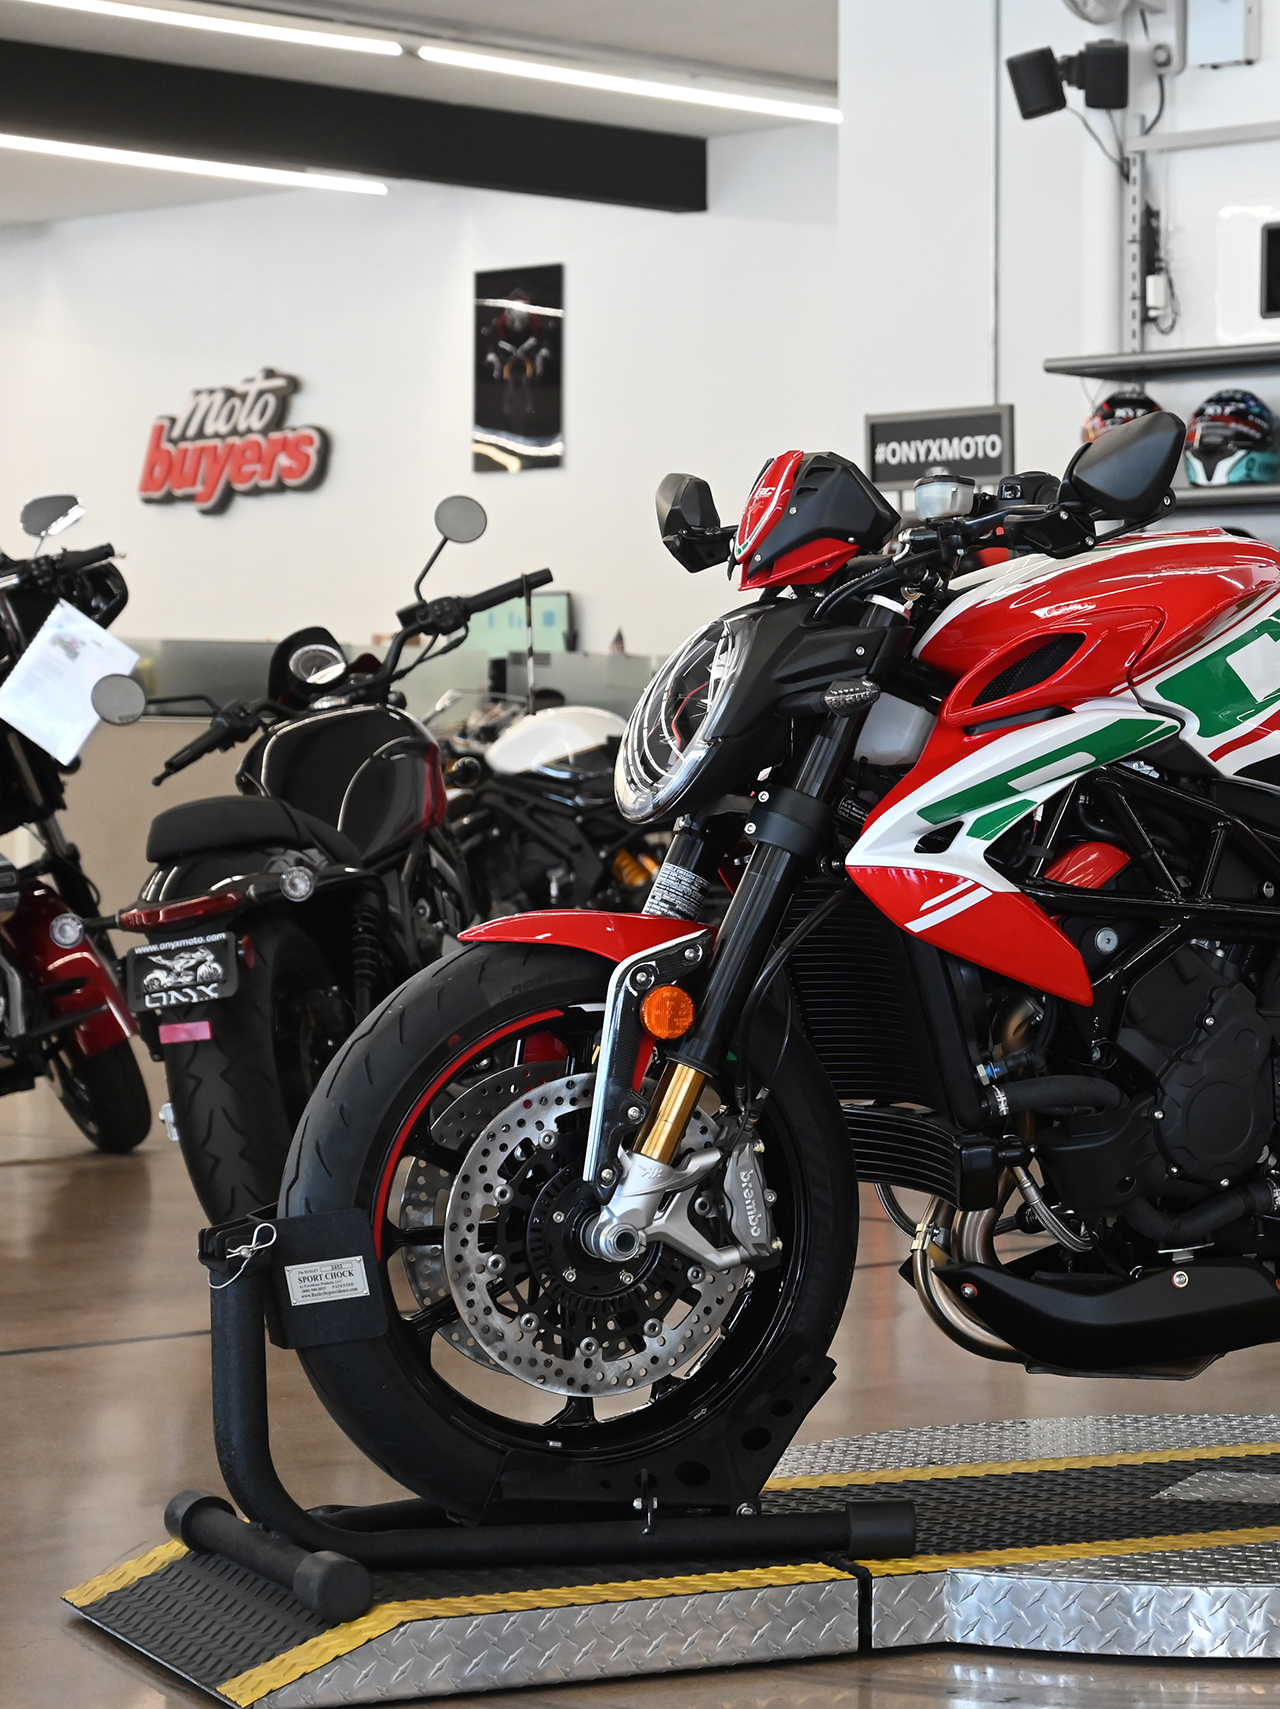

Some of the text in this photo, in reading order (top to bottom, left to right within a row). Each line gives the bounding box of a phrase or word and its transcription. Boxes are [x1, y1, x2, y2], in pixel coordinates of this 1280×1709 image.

[170, 371, 288, 439] Moto
[138, 422, 317, 506] buyers
[874, 433, 1003, 466] #ONYXMOTO
[134, 932, 226, 955] www.onyxmoto.com
[145, 983, 219, 1009] ONYX
[739, 1169, 762, 1237] brembo
[298, 1269, 355, 1284] SPORT CHOCK
